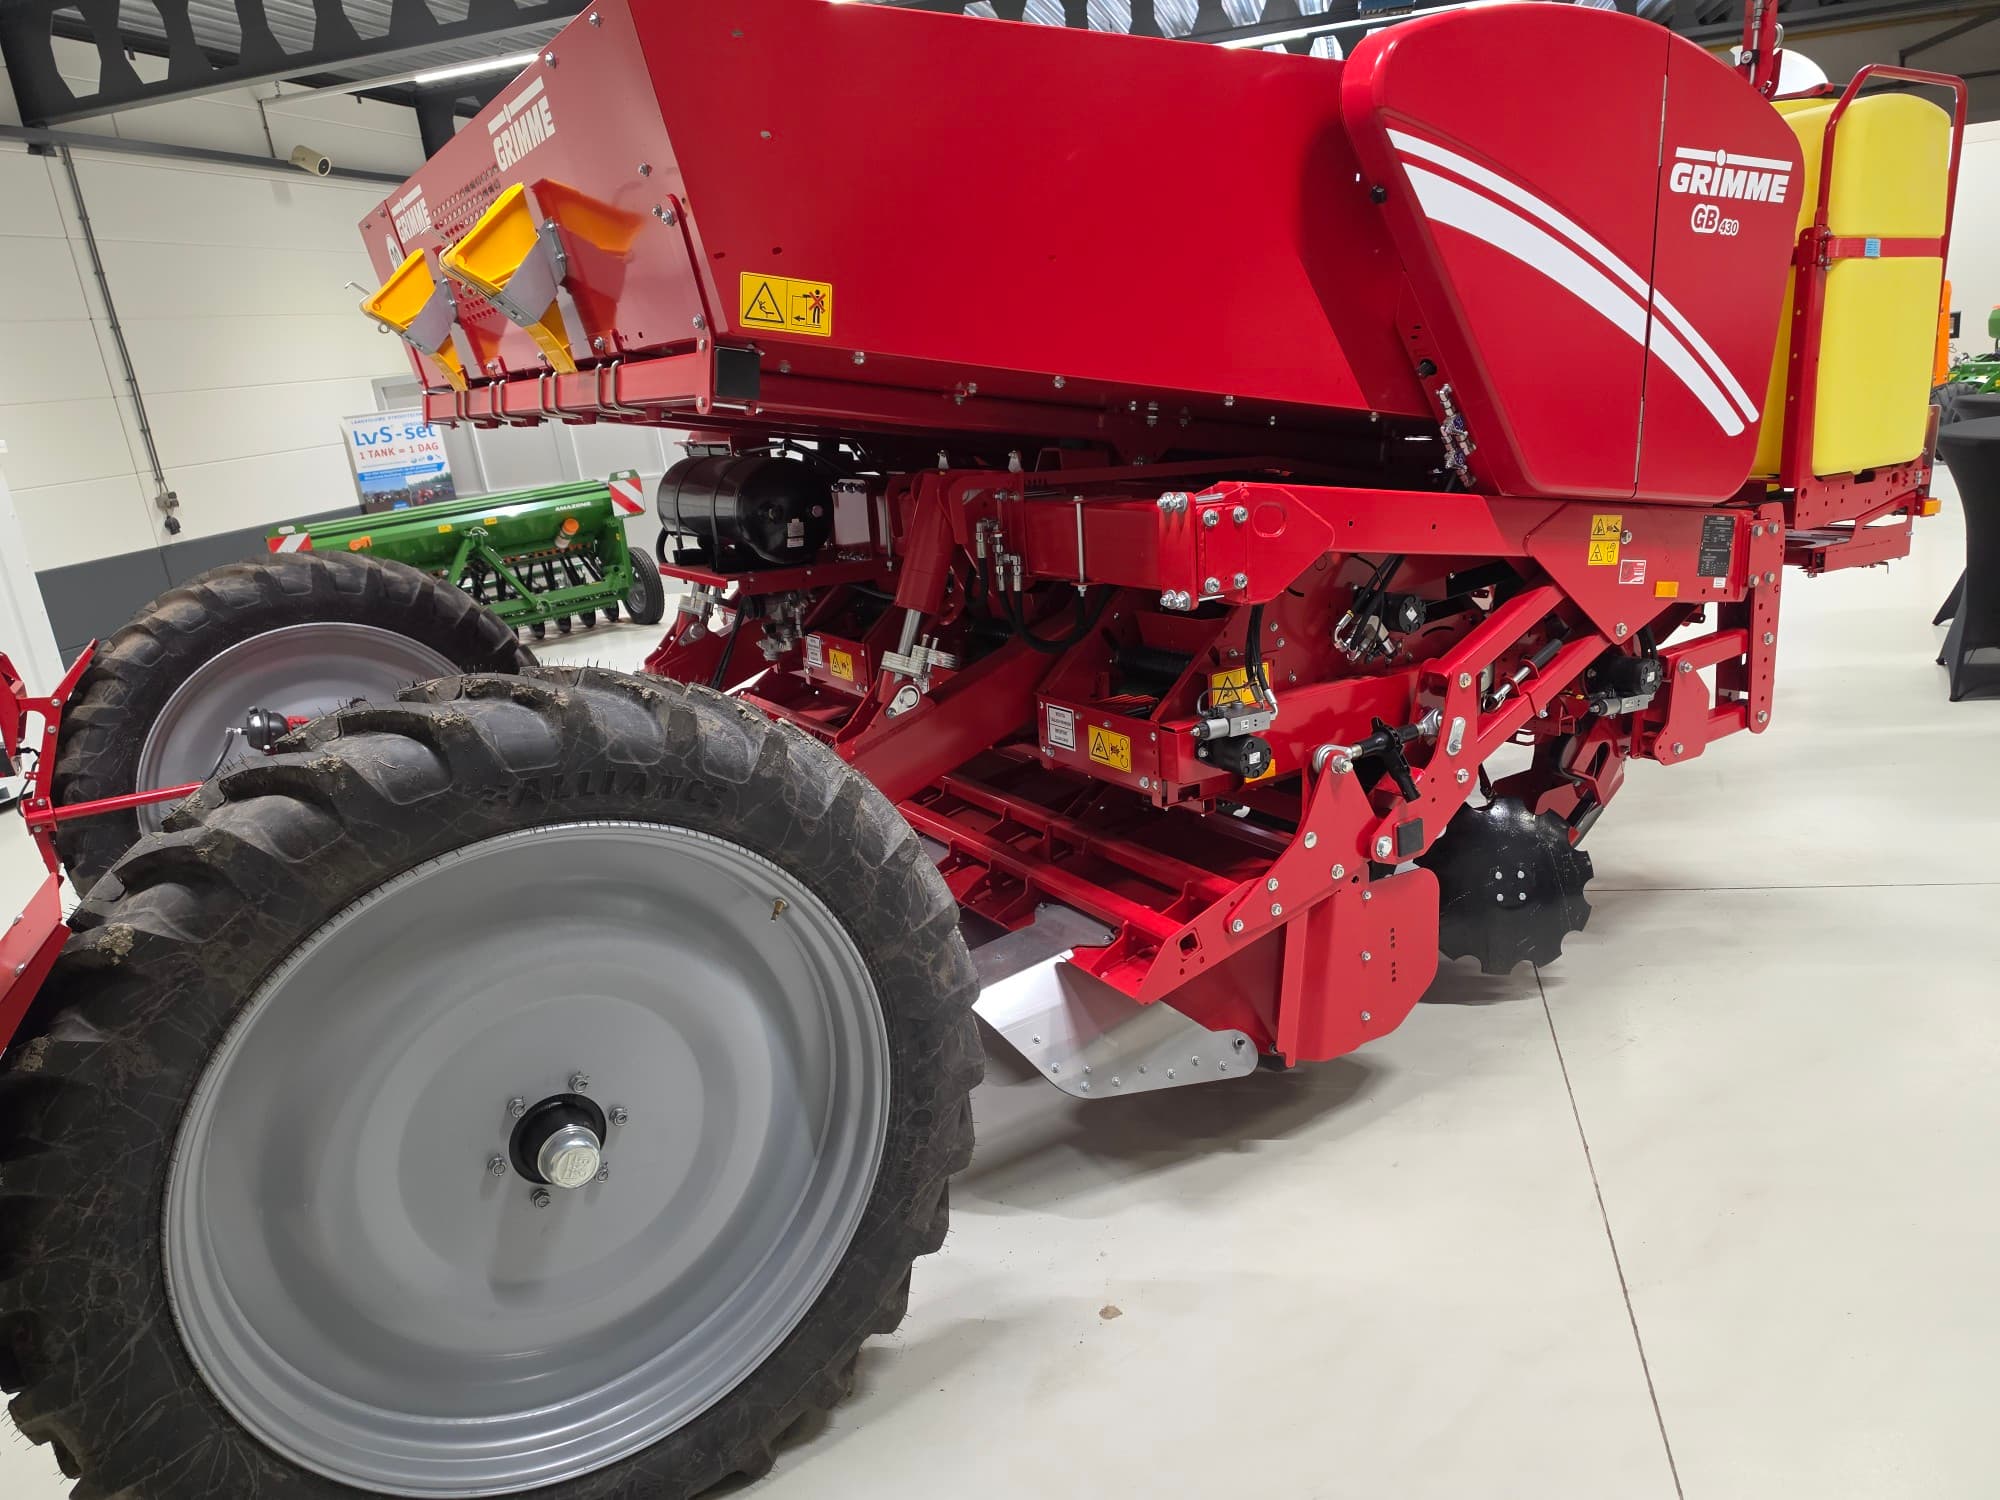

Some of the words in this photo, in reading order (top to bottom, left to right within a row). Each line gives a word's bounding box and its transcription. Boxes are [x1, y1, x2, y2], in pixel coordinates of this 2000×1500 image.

[493, 96, 555, 172] GRIMME
[1670, 162, 1789, 203] GRIMME
[396, 197, 431, 244] GRIMME
[1691, 203, 1720, 234] GB
[1718, 218, 1740, 236] 430
[368, 447, 396, 459] TANK
[409, 445, 415, 453] 1
[418, 442, 439, 452] DAG
[514, 770, 728, 804] ALLIANCE
